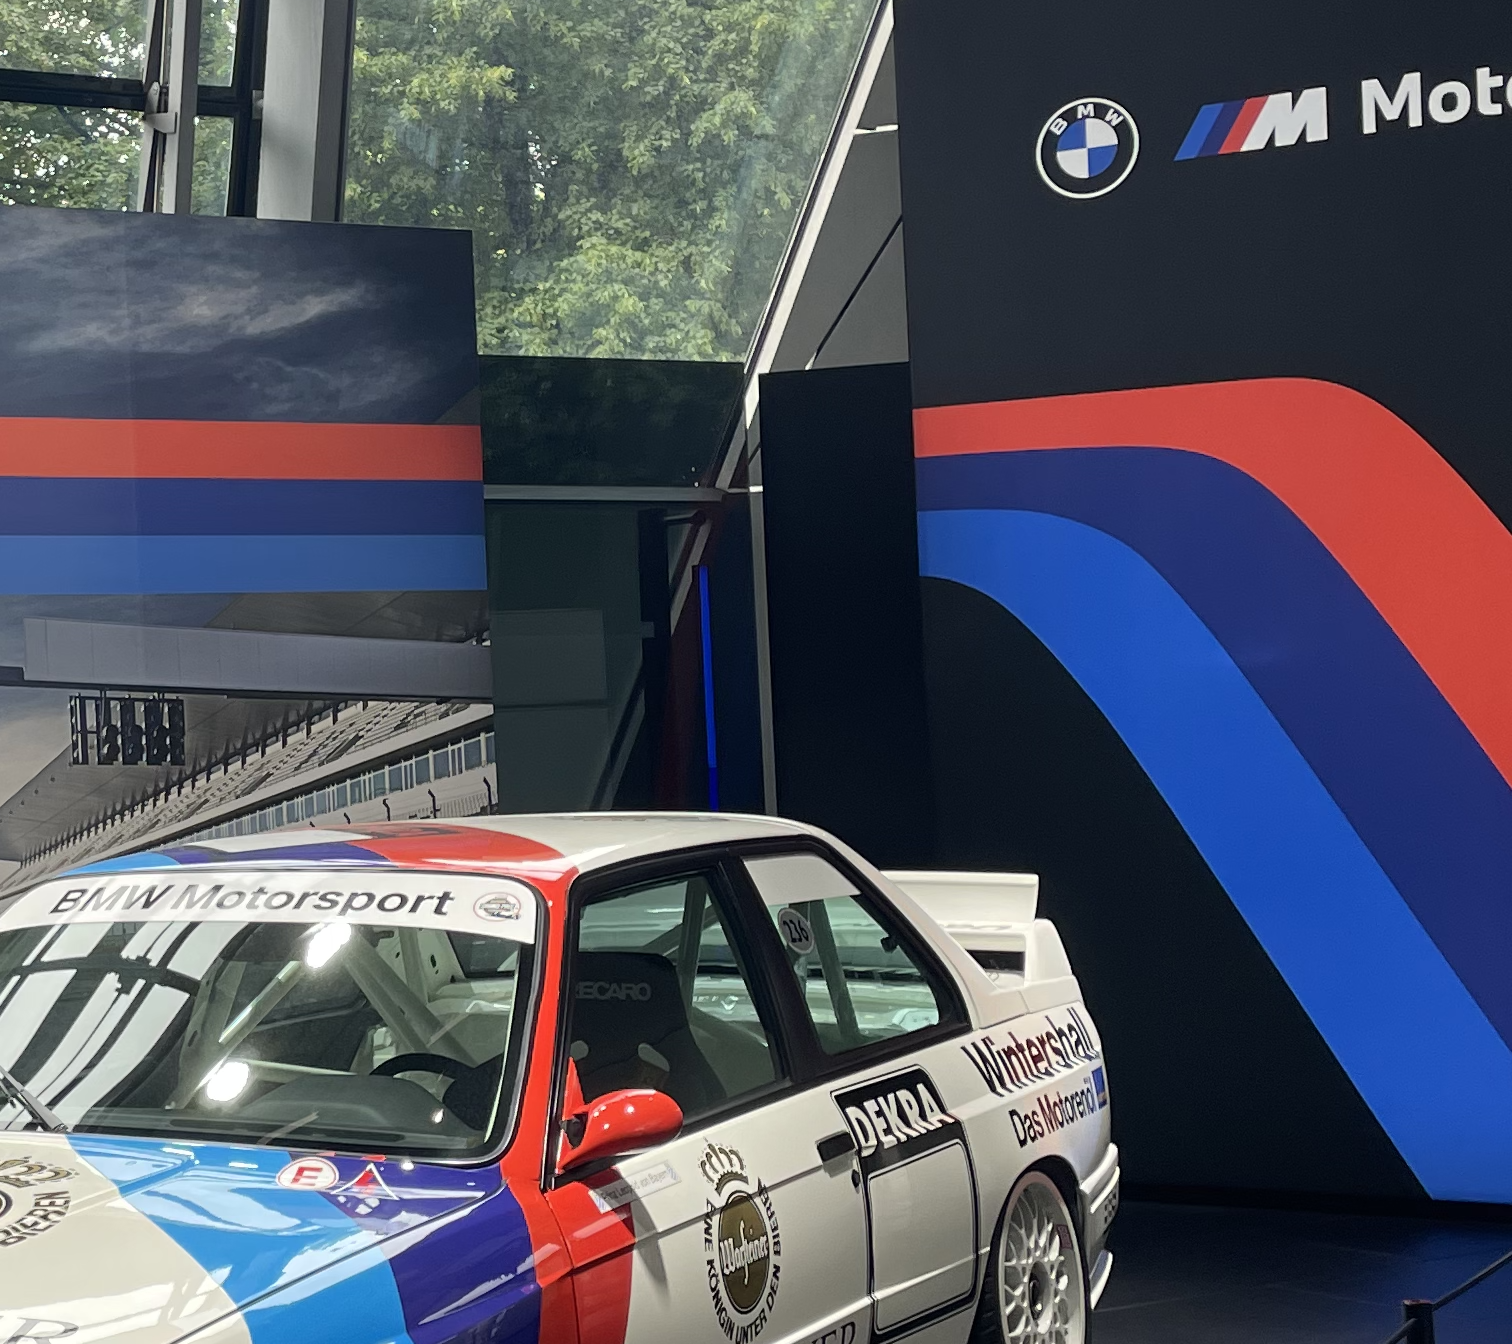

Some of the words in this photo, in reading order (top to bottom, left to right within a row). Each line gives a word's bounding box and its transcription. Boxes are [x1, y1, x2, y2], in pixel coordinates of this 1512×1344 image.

[1050, 103, 1124, 137] BMW
[1360, 65, 1512, 136] Mot
[49, 884, 176, 915] BMW
[171, 884, 455, 916] Motorsport
[782, 920, 809, 943] 236
[961, 1006, 1102, 1098] Wintershall
[845, 1082, 955, 1157] DEKRA
[1009, 1107, 1045, 1149] Das
[291, 1166, 323, 1186] E
[766, 1263, 781, 1314] DEN
